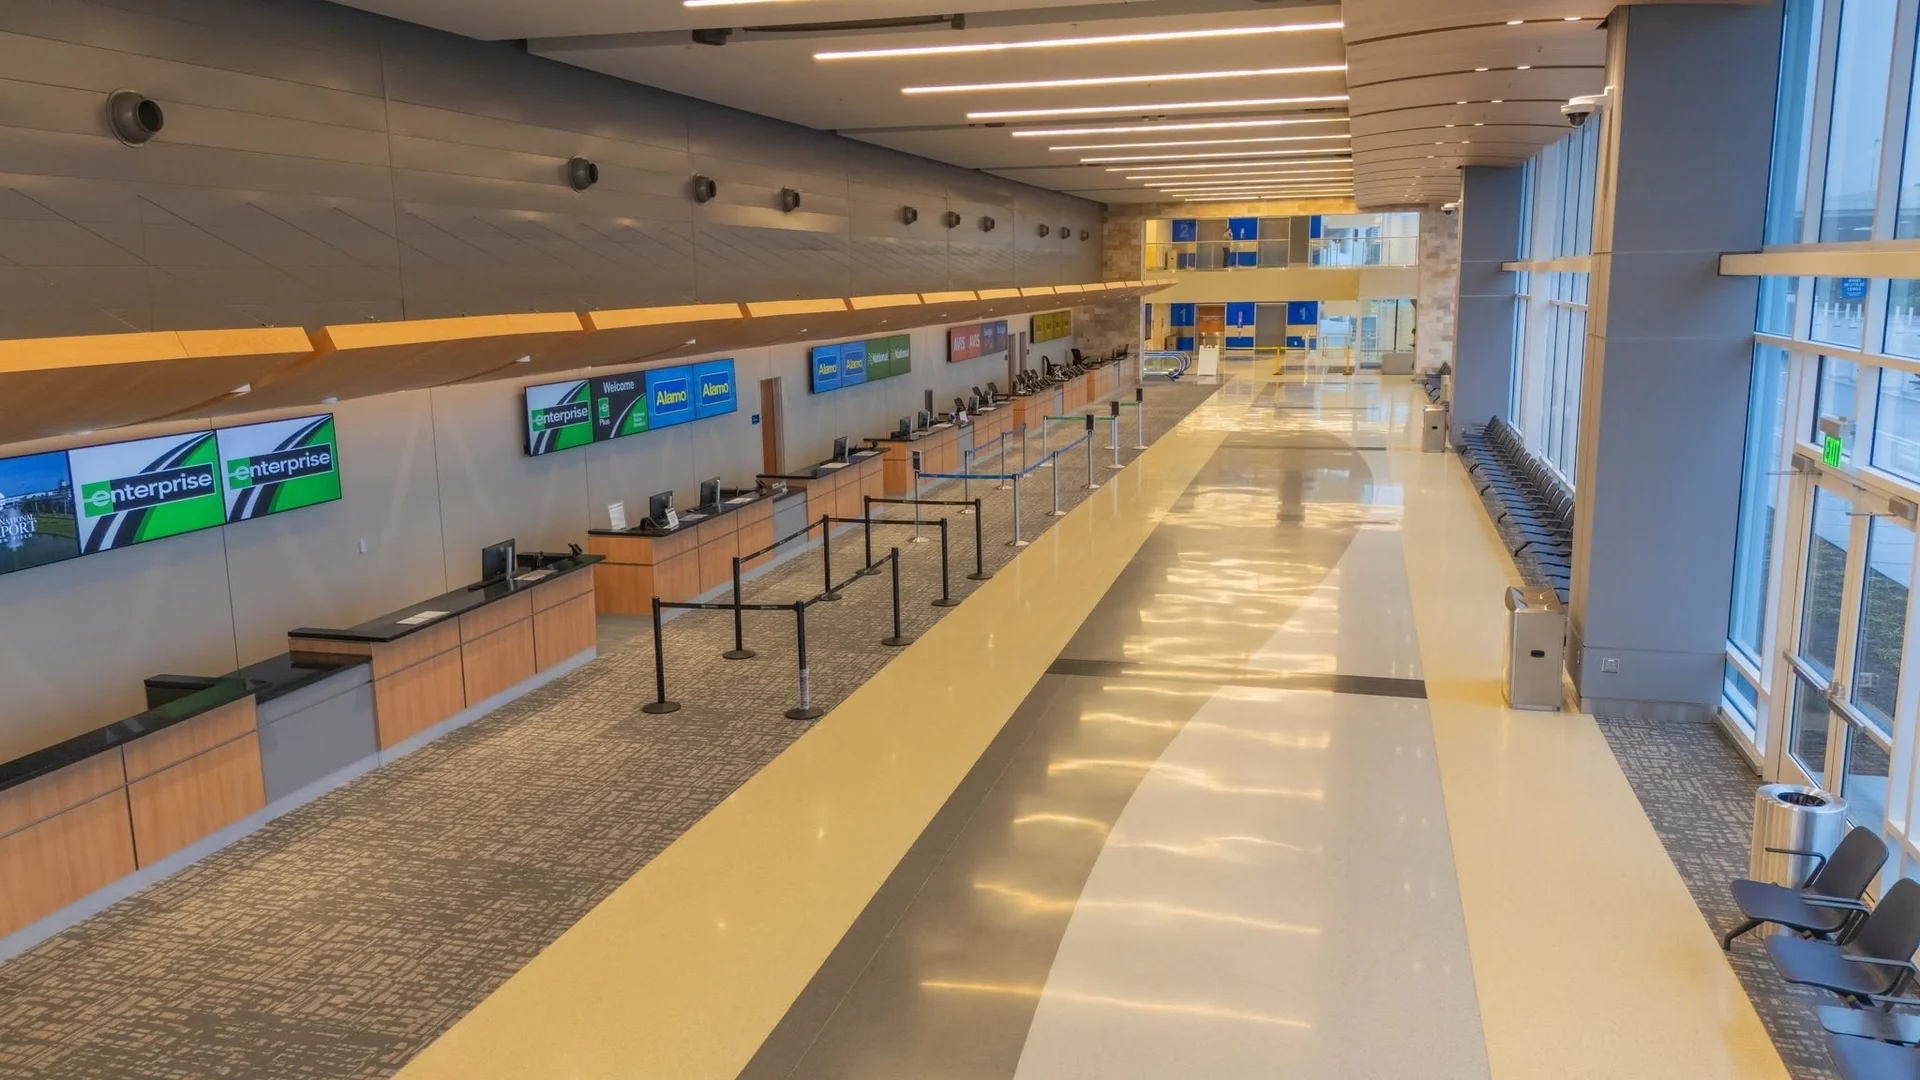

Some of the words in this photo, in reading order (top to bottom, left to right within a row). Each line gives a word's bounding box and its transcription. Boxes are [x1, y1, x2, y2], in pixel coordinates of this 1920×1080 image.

[953, 336, 965, 351] AVIS
[818, 363, 837, 375] Alamo
[846, 359, 862, 370] Alamo
[603, 381, 634, 394] Welcome
[703, 383, 729, 397] Alamo
[656, 390, 687, 406] Alamo
[533, 406, 588, 426] enterprise
[1825, 437, 1840, 467] EXIT
[229, 450, 331, 481] enterprise
[84, 473, 212, 507] enterprise
